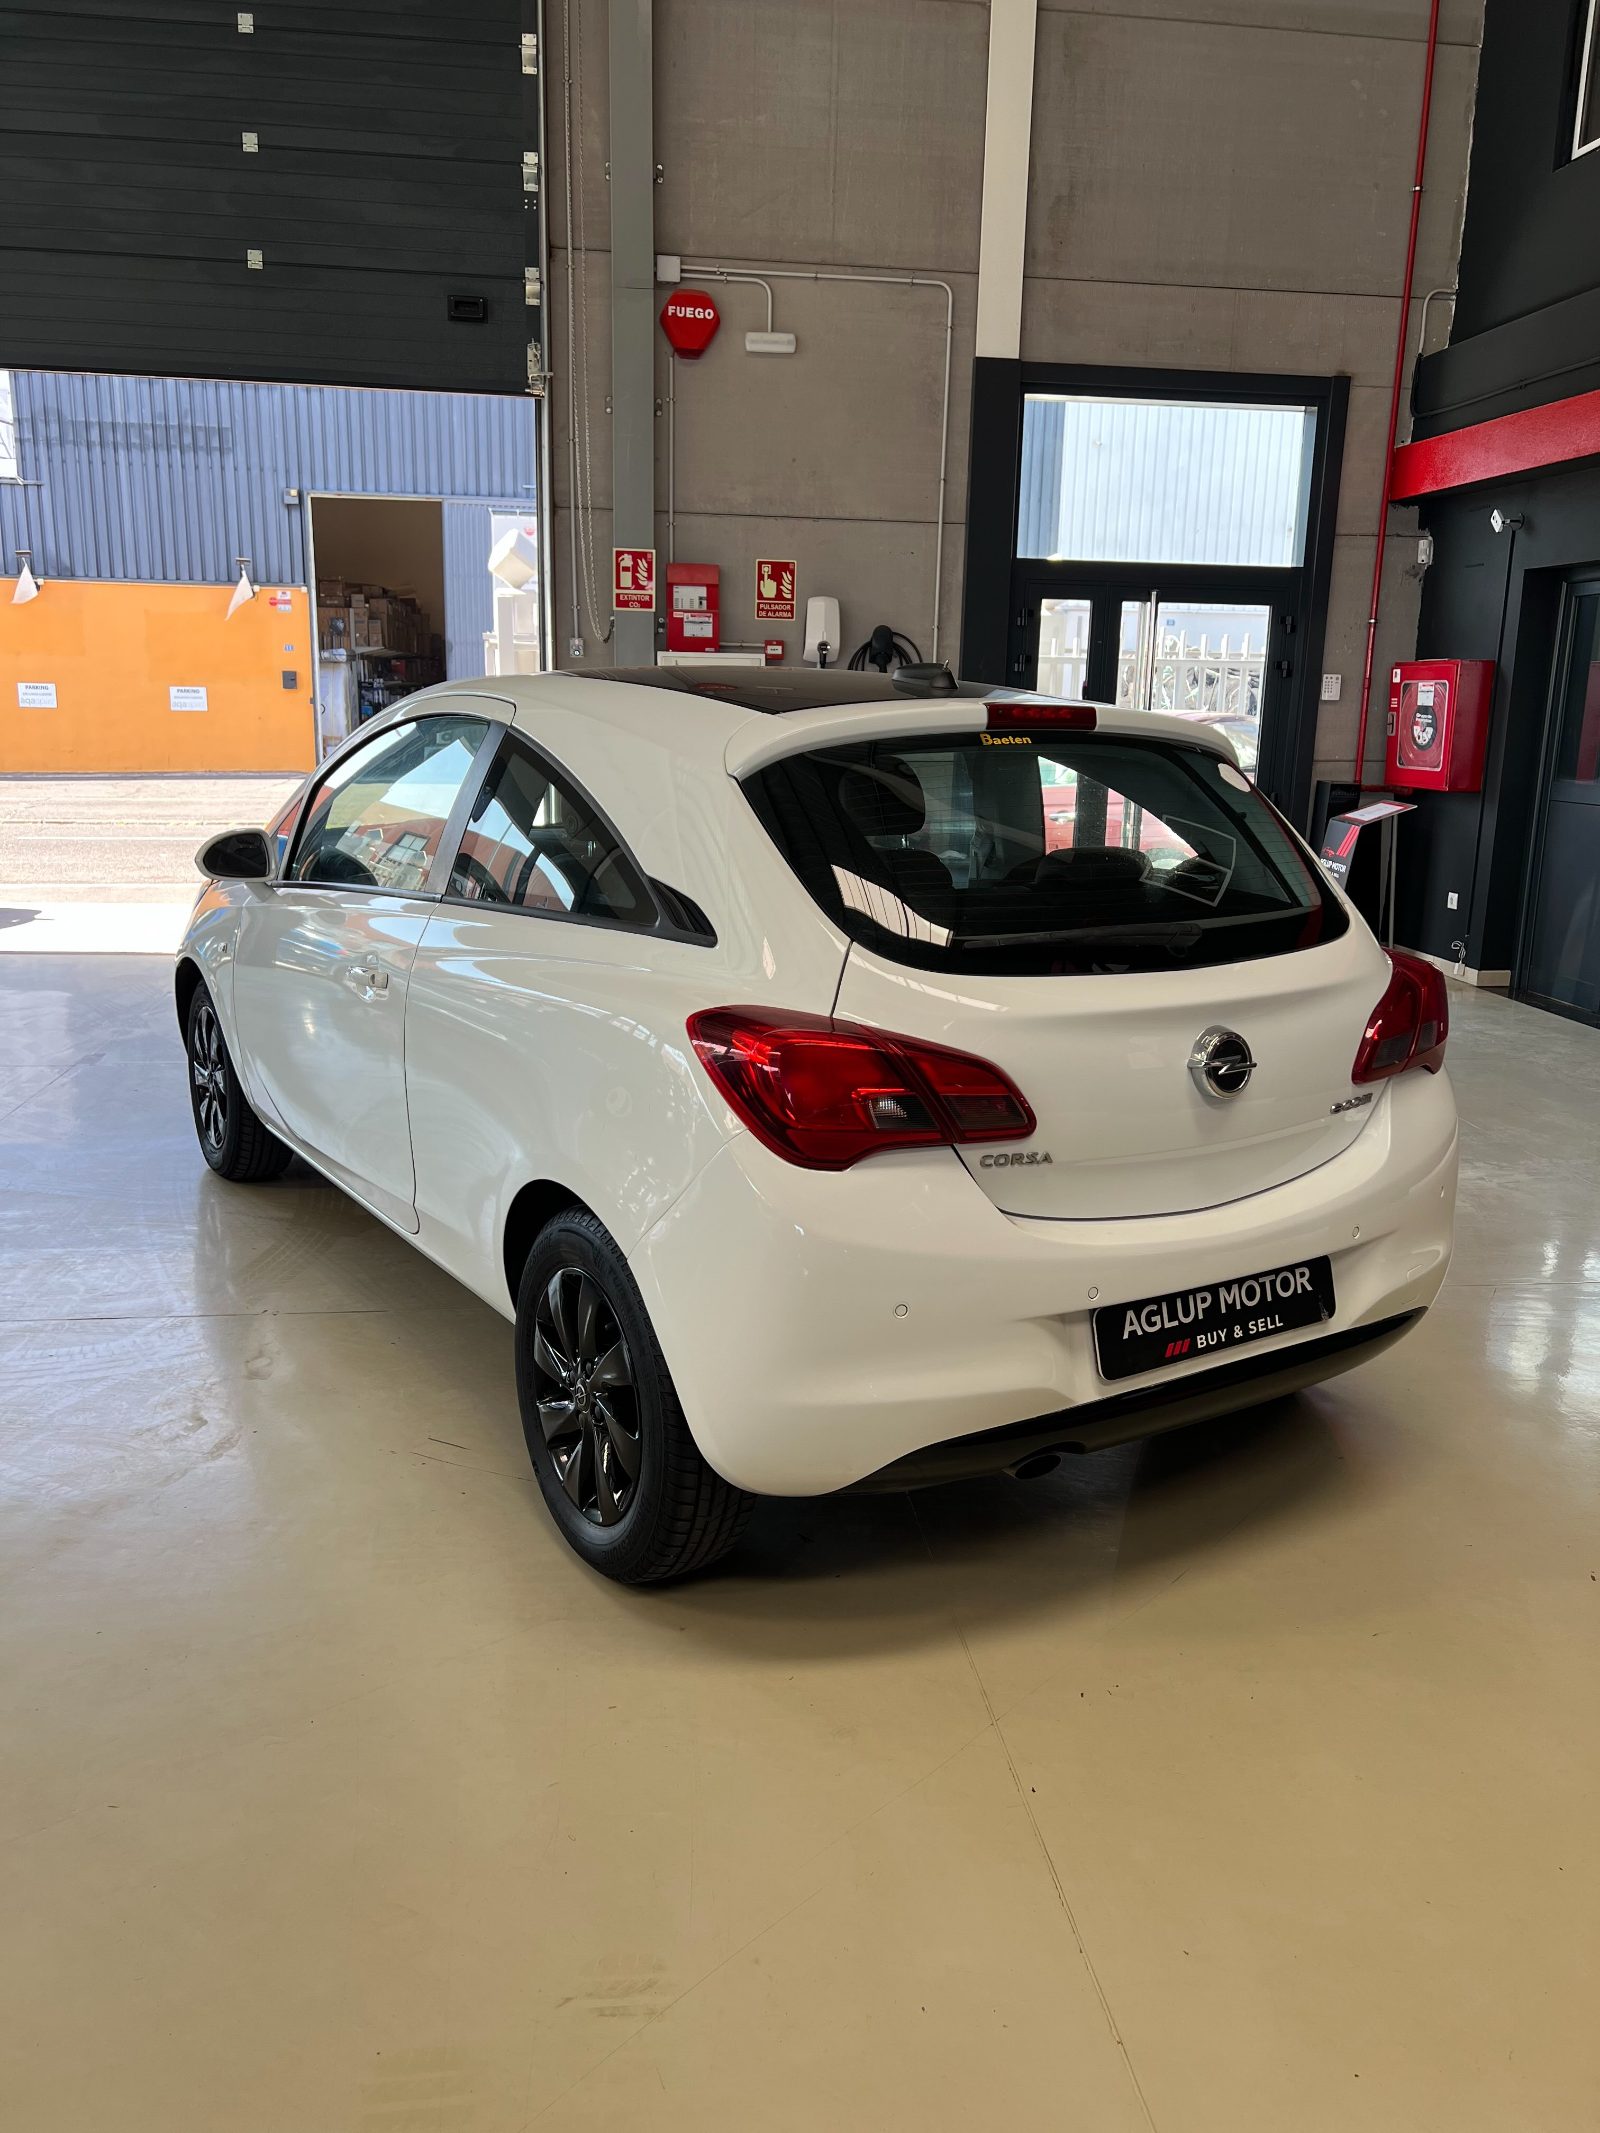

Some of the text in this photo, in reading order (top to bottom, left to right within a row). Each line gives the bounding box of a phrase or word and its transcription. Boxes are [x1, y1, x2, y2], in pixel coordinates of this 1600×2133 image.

[667, 305, 714, 319] FUEGO
[620, 594, 650, 602] EXTINTOR
[759, 603, 791, 611] PULSADOR
[980, 733, 1032, 746] Baeten
[980, 1151, 1053, 1168] CORSA
[1122, 1267, 1313, 1340] AGLUP MOTOR
[1196, 1314, 1284, 1349] BUY & SELL
